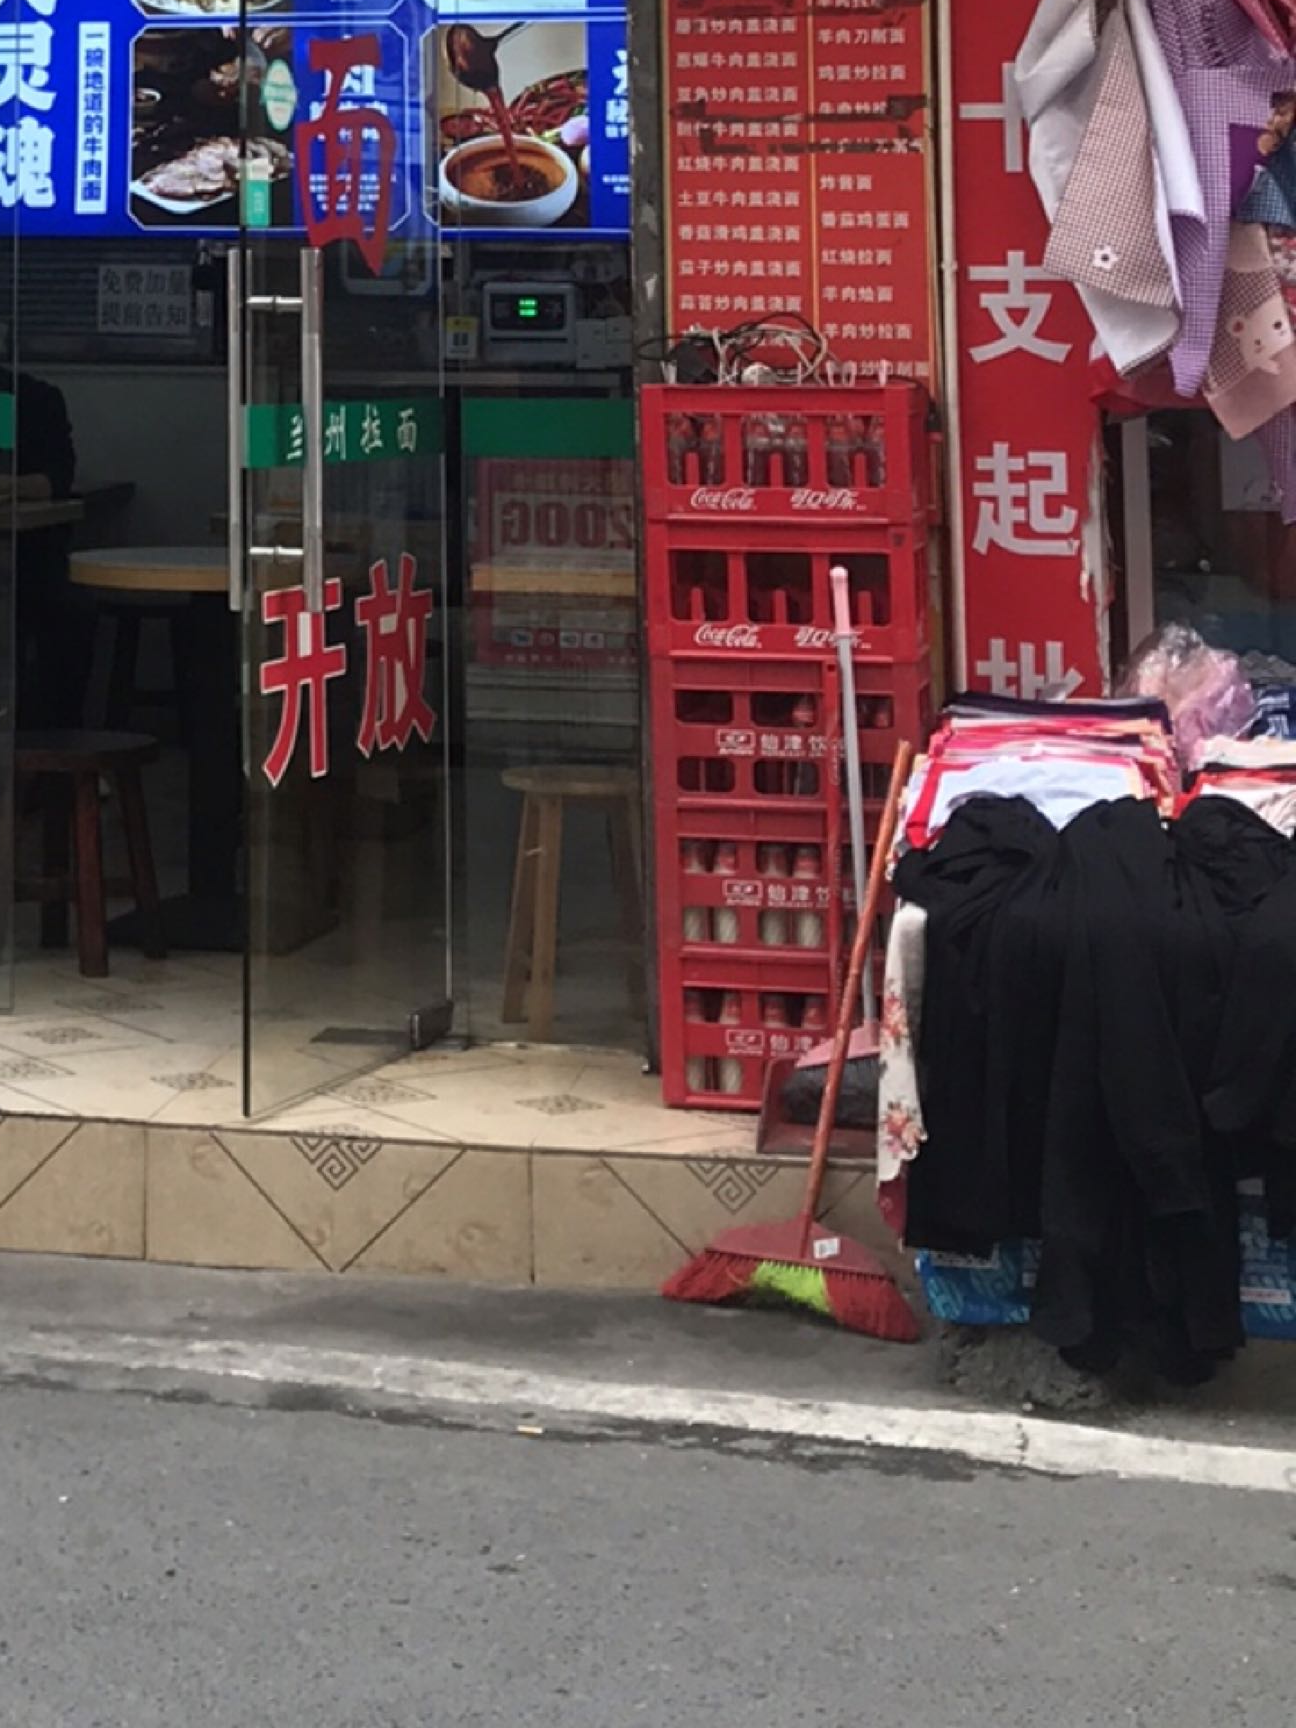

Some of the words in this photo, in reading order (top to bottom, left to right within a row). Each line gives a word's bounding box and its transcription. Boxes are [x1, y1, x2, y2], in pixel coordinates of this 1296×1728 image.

[287, 403, 419, 461] 兰州拉面
[260, 553, 438, 788] 开放
